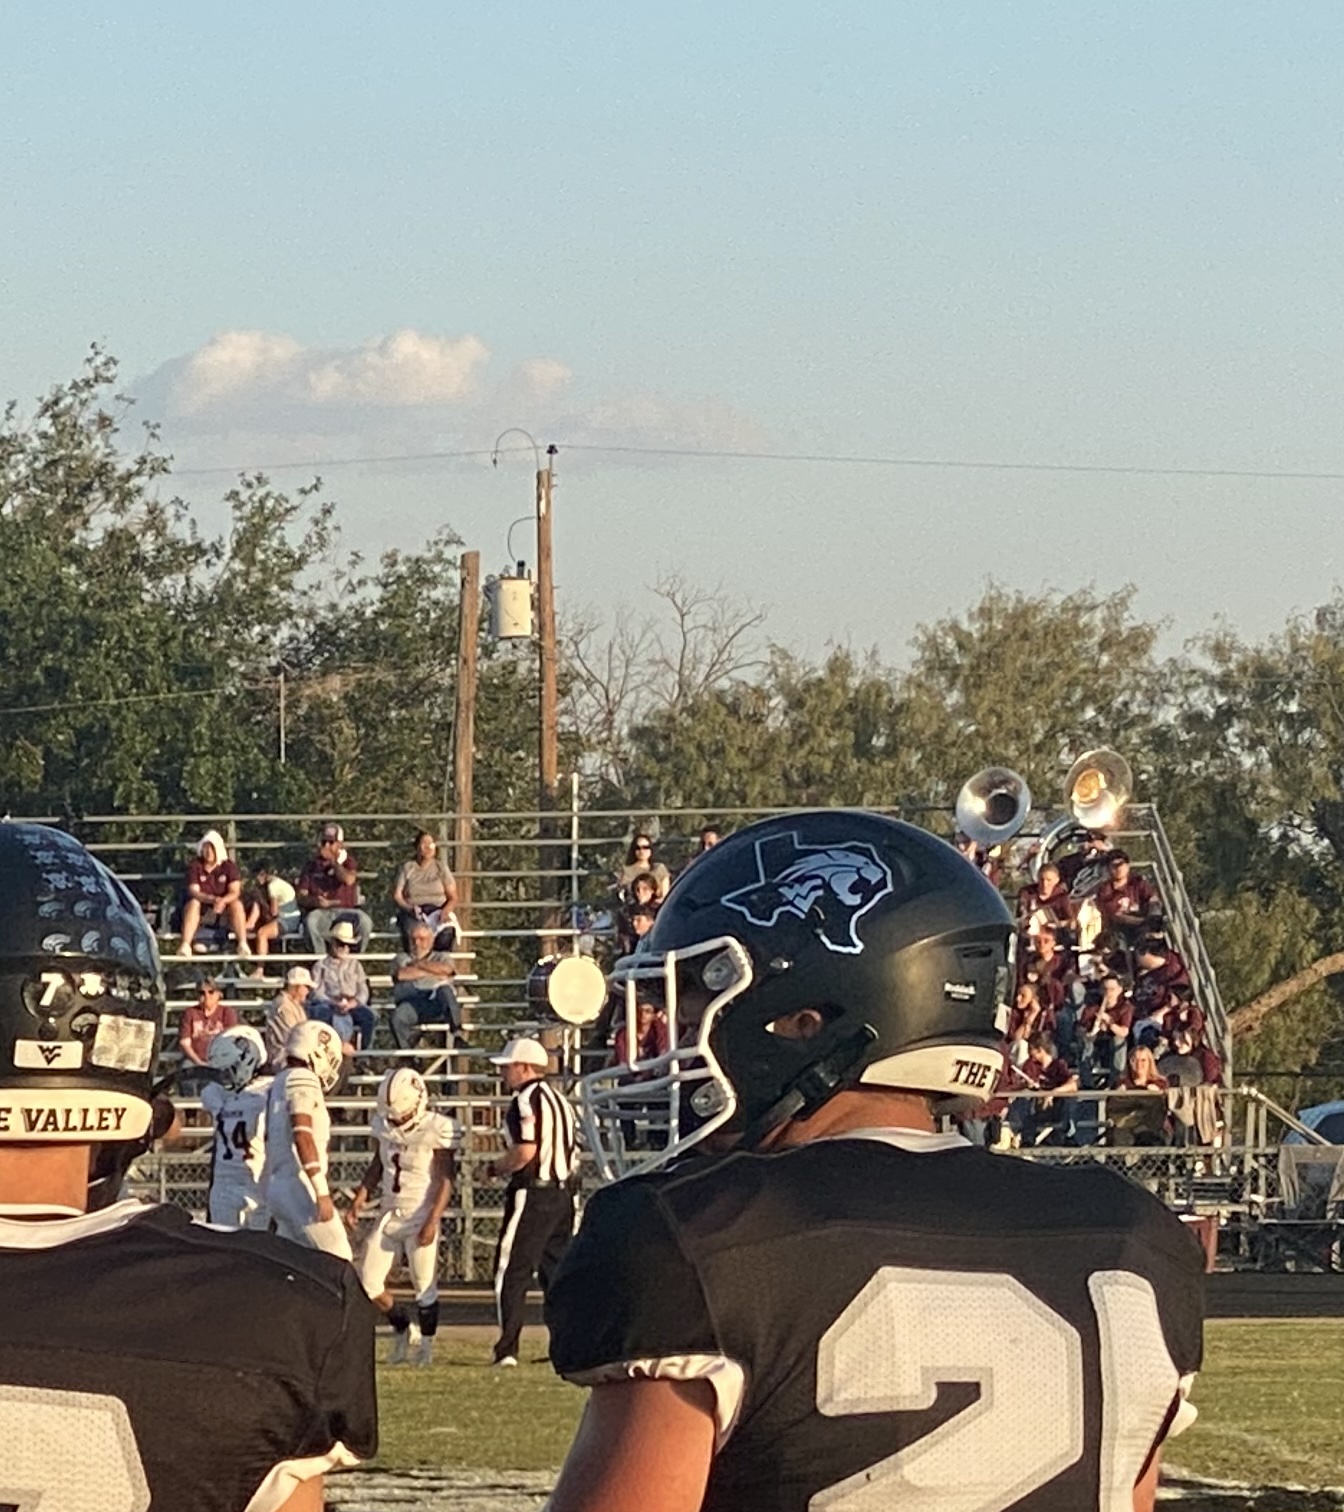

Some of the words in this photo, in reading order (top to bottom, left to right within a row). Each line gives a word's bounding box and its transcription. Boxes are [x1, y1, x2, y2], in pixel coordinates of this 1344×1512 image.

[40, 972, 65, 1006] 7
[951, 1058, 992, 1089] THE
[21, 1106, 128, 1133] VALLEY
[216, 1112, 255, 1161] 14
